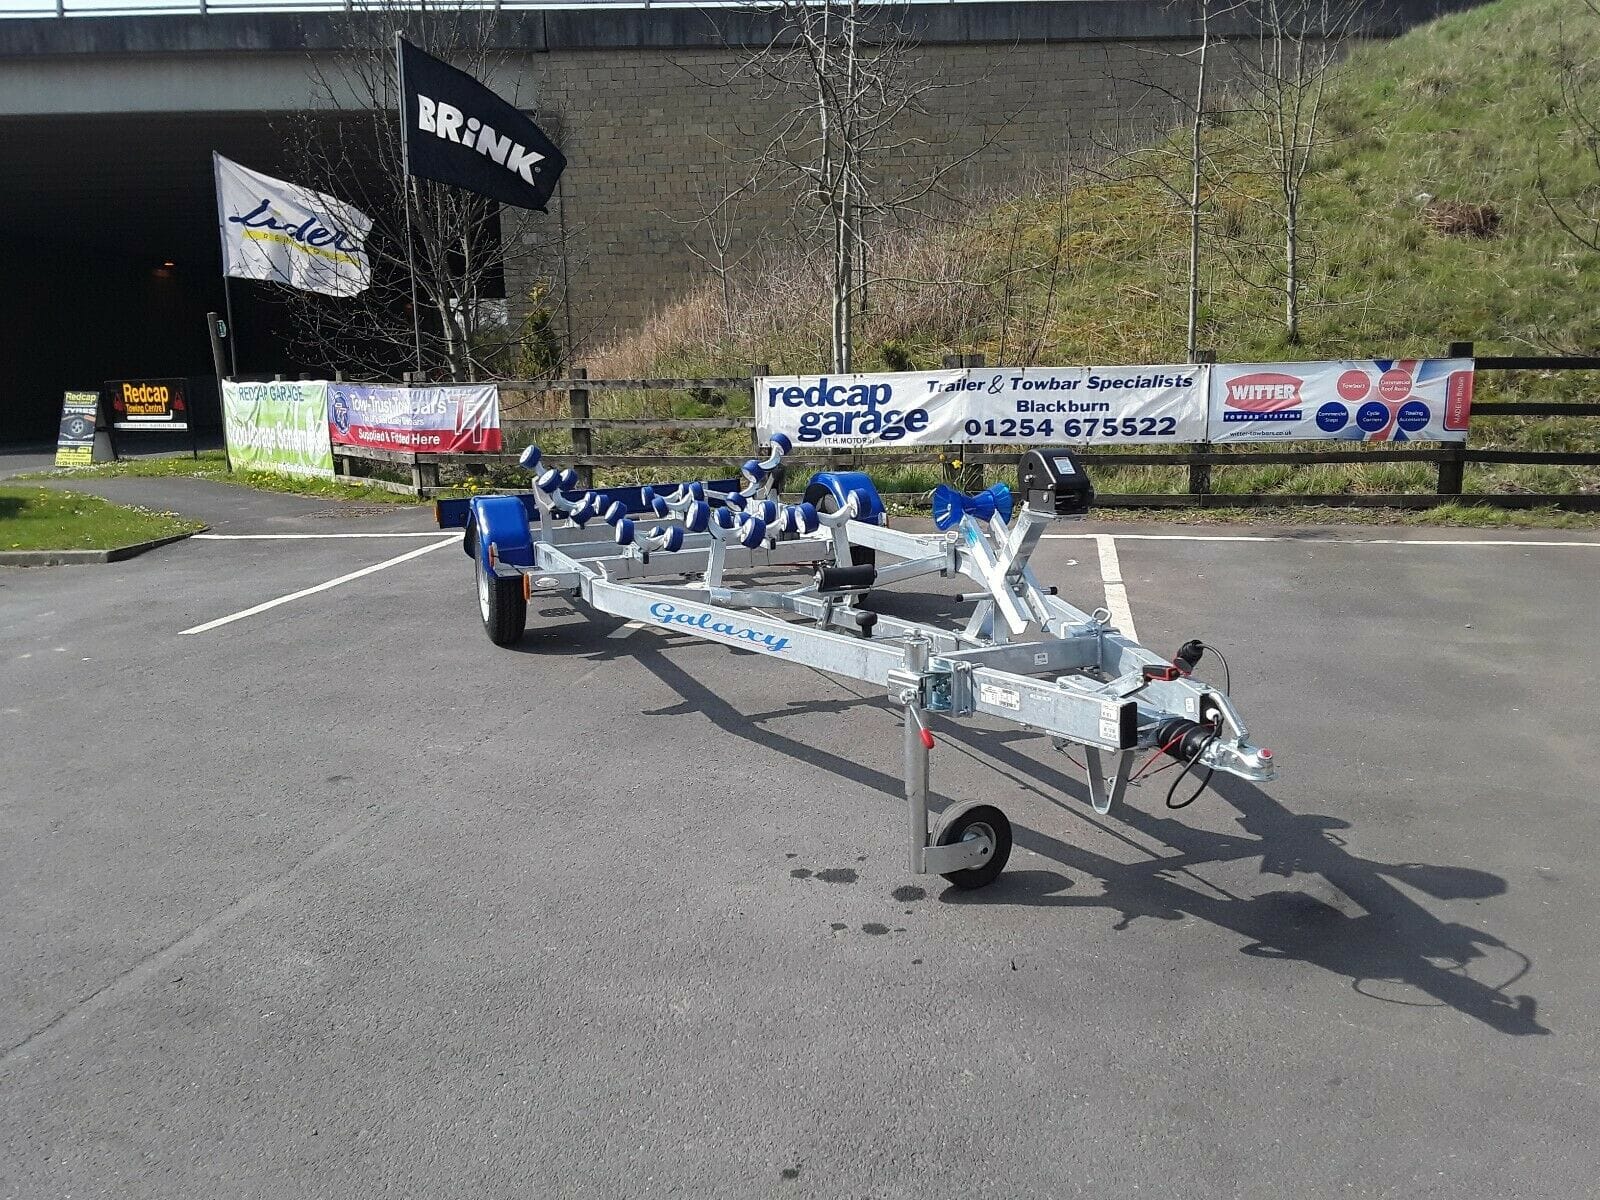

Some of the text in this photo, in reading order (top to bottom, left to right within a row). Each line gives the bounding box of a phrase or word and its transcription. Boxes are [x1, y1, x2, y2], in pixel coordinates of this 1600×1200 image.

[926, 374, 1194, 394] Trailer & Towbar Specialists
[1231, 384, 1296, 400] WITTER
[65, 392, 97, 404] Redcap
[123, 383, 169, 410] Redcap
[239, 386, 305, 402] REDCAP GARAGE
[768, 378, 893, 413] redcap
[63, 407, 96, 415] TYRES
[127, 404, 162, 413] Towing Centre
[350, 394, 393, 414] Tow-Trust
[1016, 400, 1110, 412] Blackburn
[798, 408, 929, 442] garage
[964, 416, 1176, 437] 01254 675522
[358, 429, 386, 442] Supplied
[391, 431, 410, 445] Fitted
[411, 434, 441, 445] Here
[650, 602, 793, 652] Galaxy
